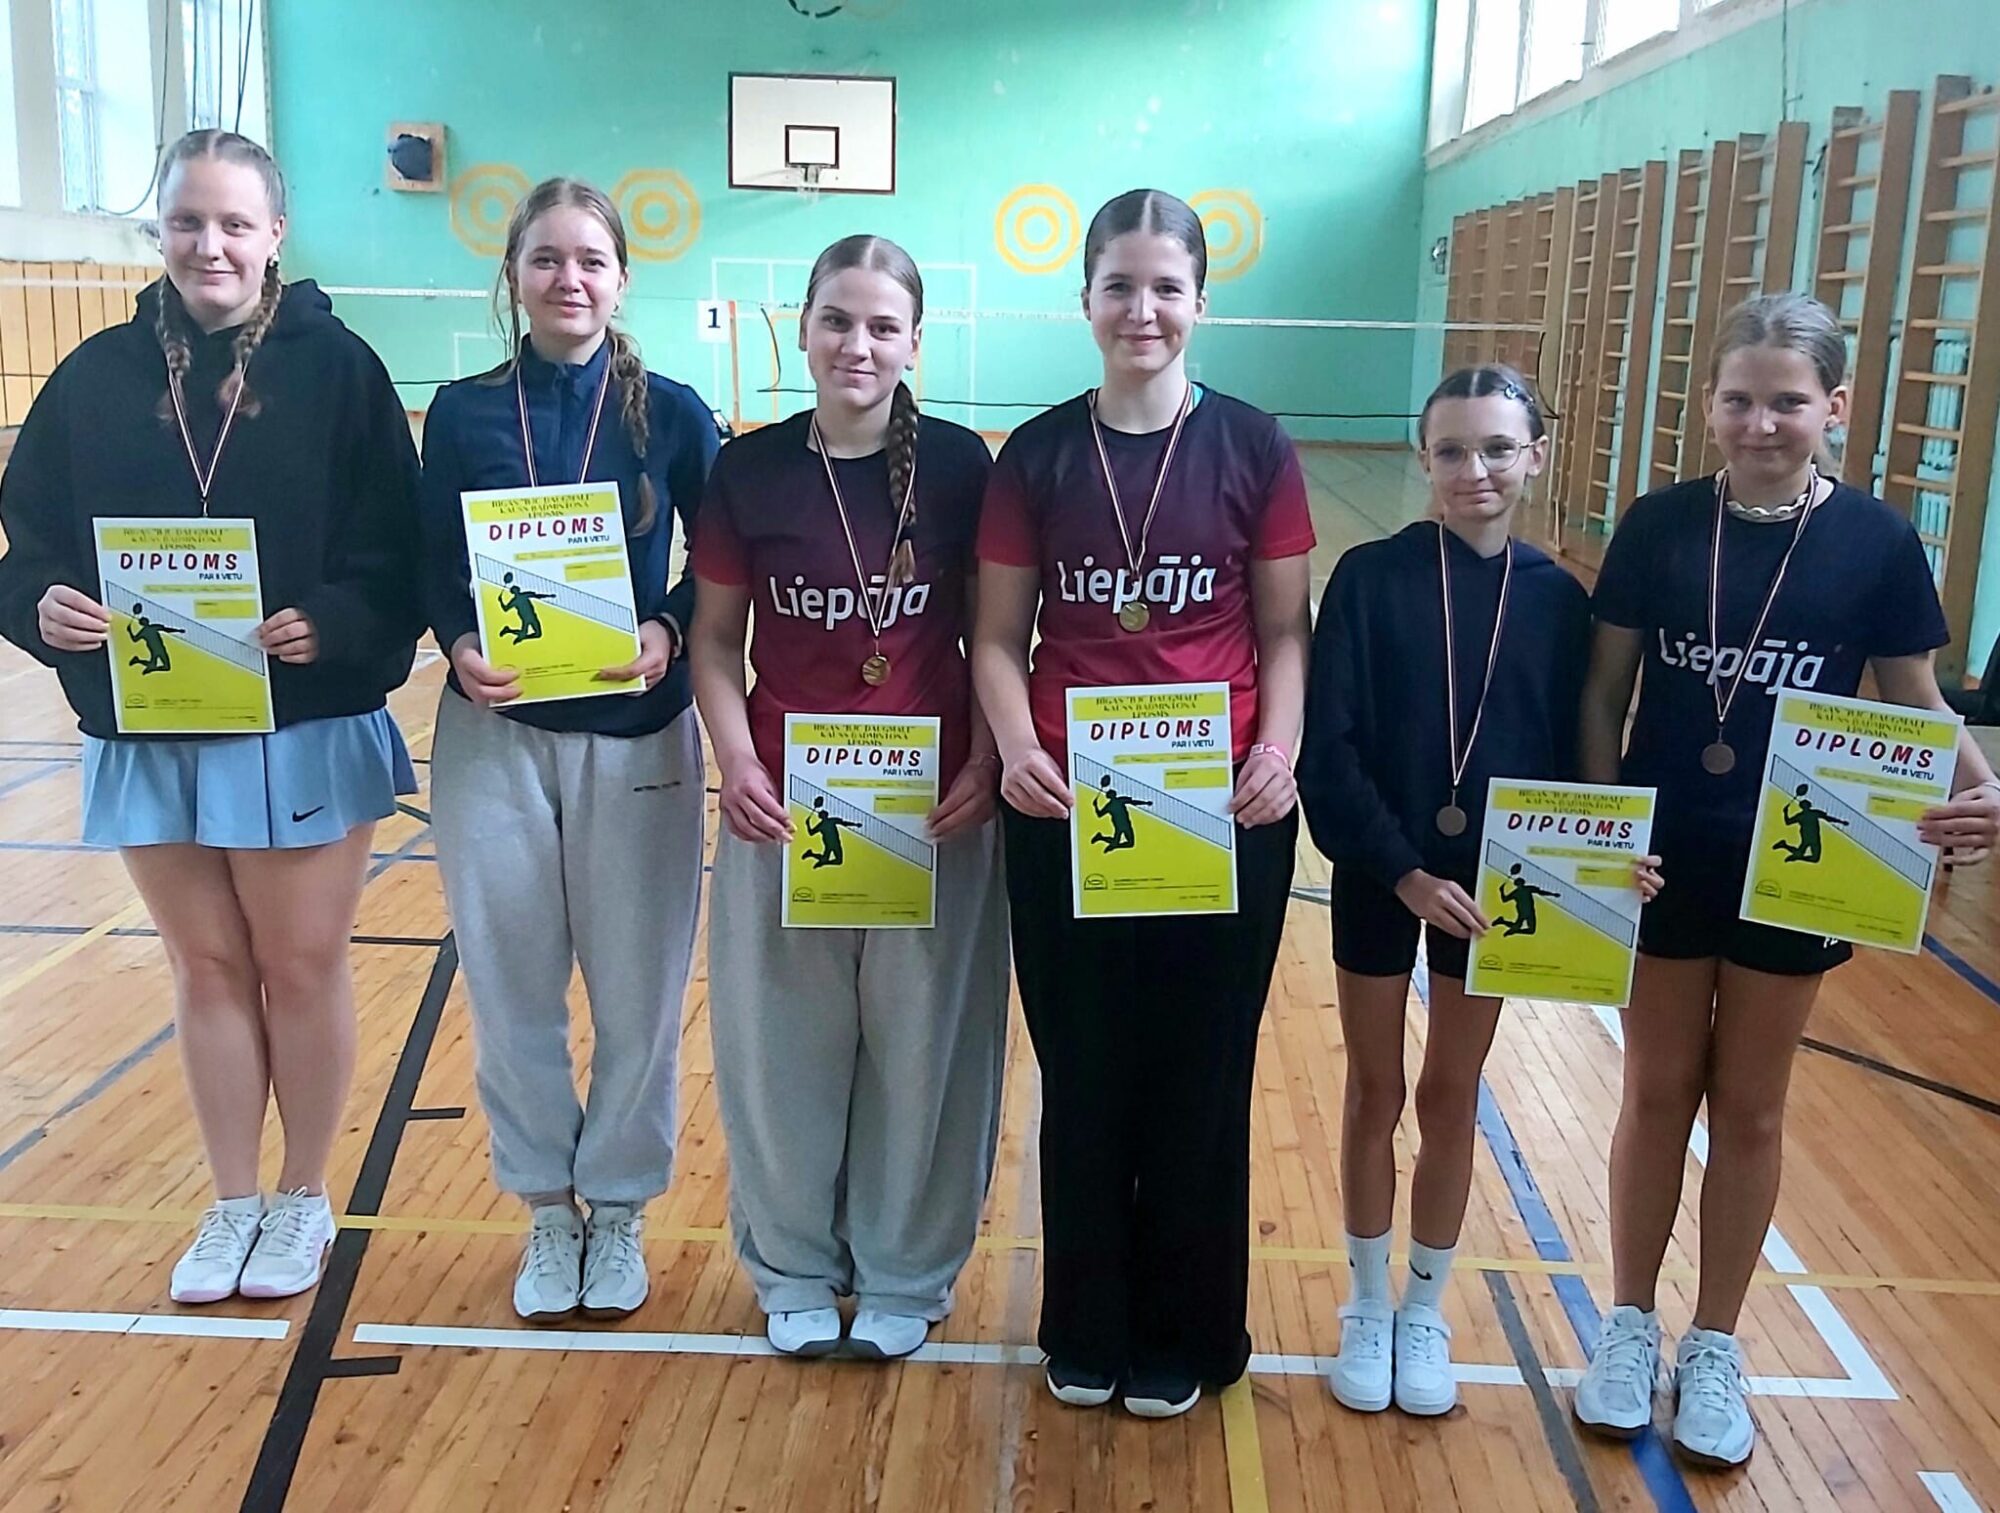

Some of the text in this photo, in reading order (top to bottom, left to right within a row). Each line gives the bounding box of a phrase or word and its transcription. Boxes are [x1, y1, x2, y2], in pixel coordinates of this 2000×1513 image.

[708, 308, 720, 328] 1
[489, 516, 605, 541] DIPLOMS
[568, 536, 582, 544] PAR
[120, 553, 238, 571] DIPLOMS
[1057, 555, 1217, 614] Liepāja
[1659, 627, 1825, 695] Liepāja
[1090, 719, 1211, 741] DIPLOMS
[1171, 740, 1186, 748] PAR
[1795, 728, 1934, 769] DIPLOMS
[806, 747, 921, 767] DIPLOMS
[1882, 765, 1899, 774] PAR
[1507, 812, 1633, 839] DIPLOMS
